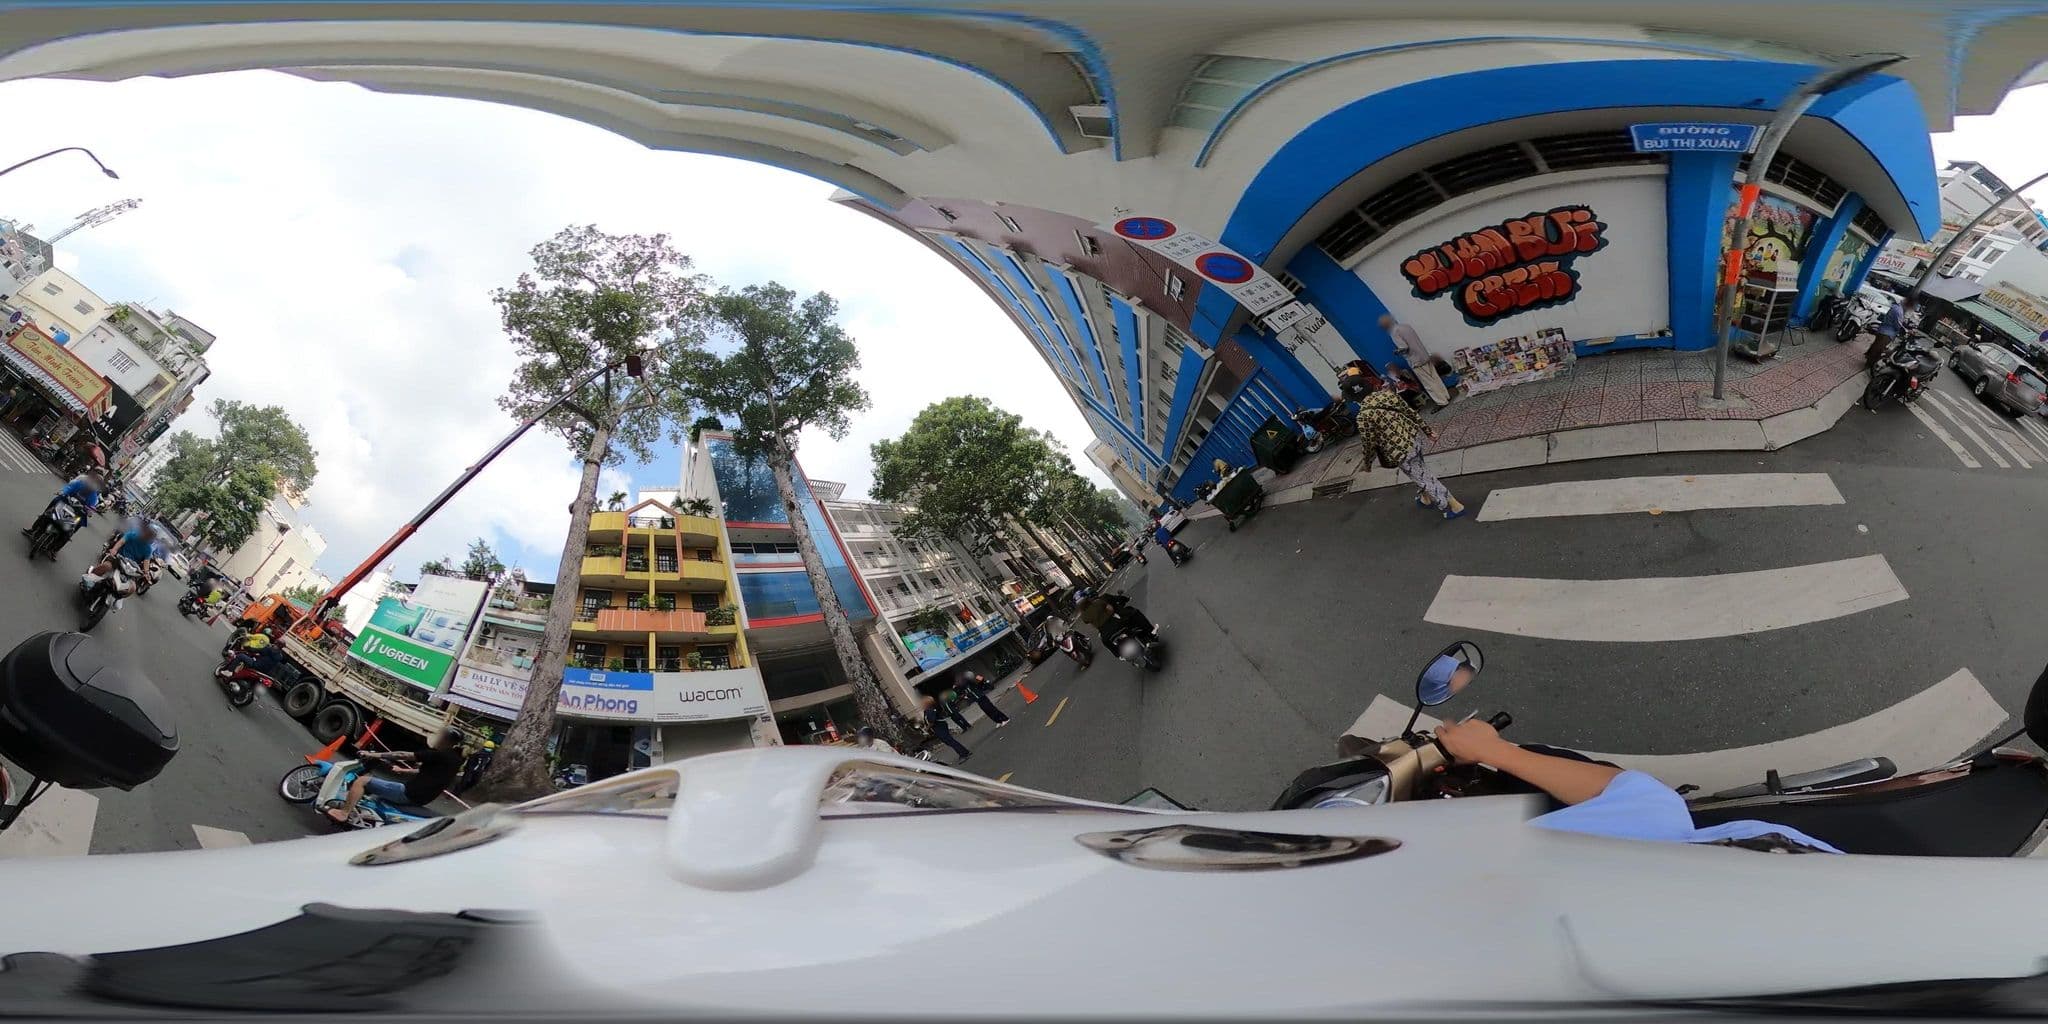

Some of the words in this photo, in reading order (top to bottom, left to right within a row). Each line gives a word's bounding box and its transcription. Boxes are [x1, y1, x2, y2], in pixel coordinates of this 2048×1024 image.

[378, 644, 429, 671] UGREEN
[559, 690, 581, 709] An
[584, 694, 638, 715] Phong
